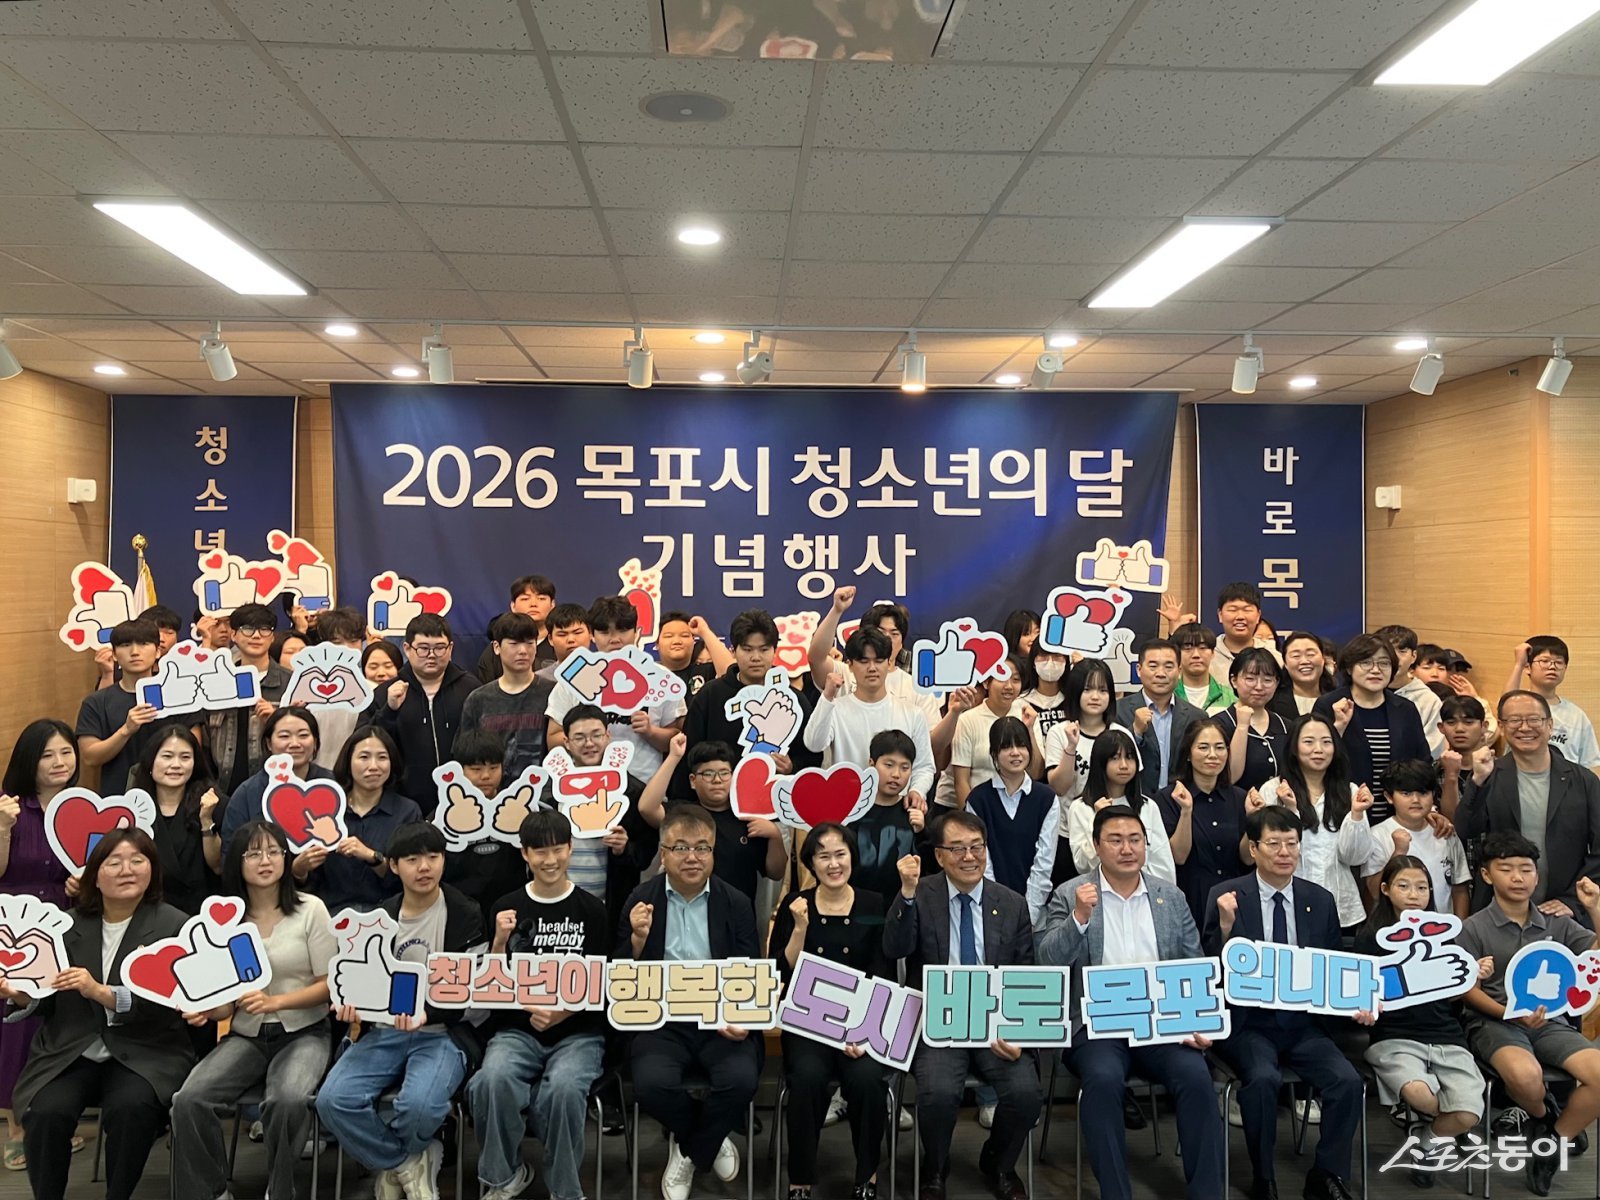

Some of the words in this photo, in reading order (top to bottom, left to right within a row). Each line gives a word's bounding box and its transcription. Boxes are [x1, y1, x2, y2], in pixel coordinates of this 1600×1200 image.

[383, 443, 558, 509] 2026
[575, 445, 770, 516] 목포시
[791, 446, 1047, 519] 청소년의
[1069, 449, 1134, 518] 달
[642, 533, 916, 599] 기념행사
[533, 931, 585, 948] melody
[538, 916, 584, 933] headset
[427, 956, 603, 1006] 청소년이
[608, 963, 778, 1025] 행복한
[780, 959, 923, 1063] 도시
[926, 970, 1067, 1042] 바로
[1086, 962, 1224, 1041] 목포
[1226, 943, 1380, 1012] 입니다
